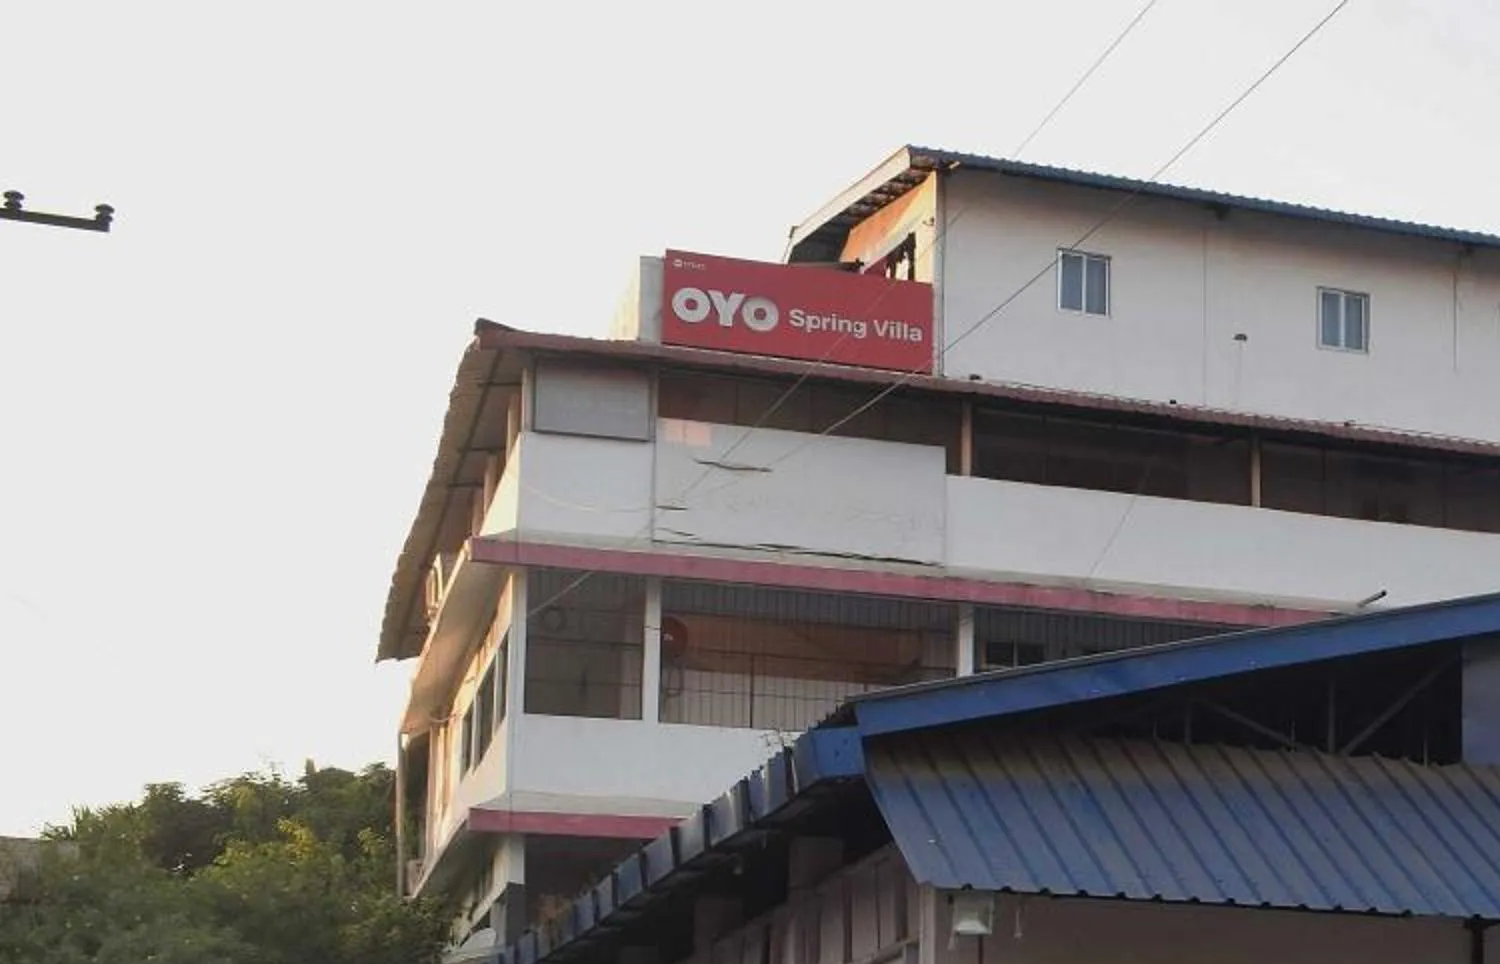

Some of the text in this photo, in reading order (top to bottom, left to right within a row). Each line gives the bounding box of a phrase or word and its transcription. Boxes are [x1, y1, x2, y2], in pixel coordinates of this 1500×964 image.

[671, 287, 923, 341] OYO Spring Villa
